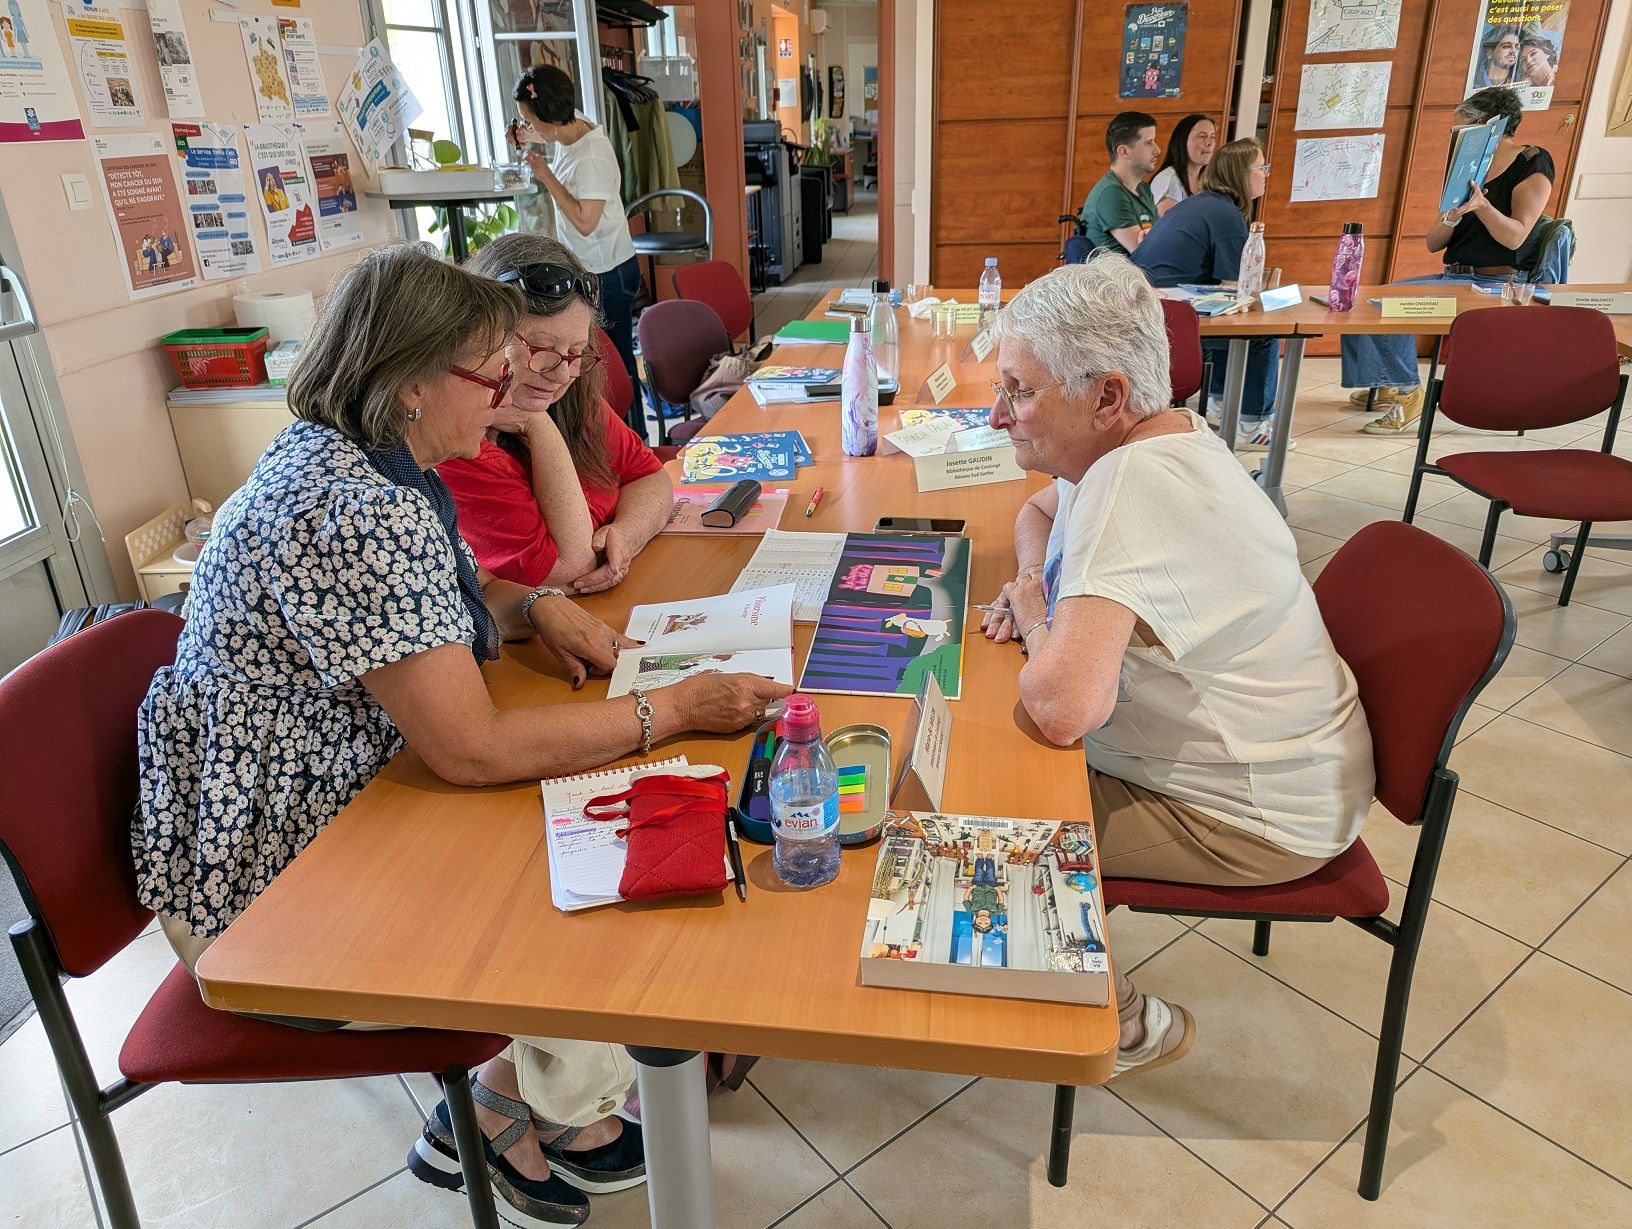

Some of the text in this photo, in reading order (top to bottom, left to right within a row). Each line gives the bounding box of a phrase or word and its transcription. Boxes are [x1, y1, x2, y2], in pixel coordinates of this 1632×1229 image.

[1489, 6, 1509, 14] c'est
[1510, 5, 1529, 13] aussi
[1541, 5, 1563, 13] poser
[1503, 14, 1543, 24] questions.
[946, 456, 992, 467] Josette GAUDIN
[784, 818, 818, 828] evian
